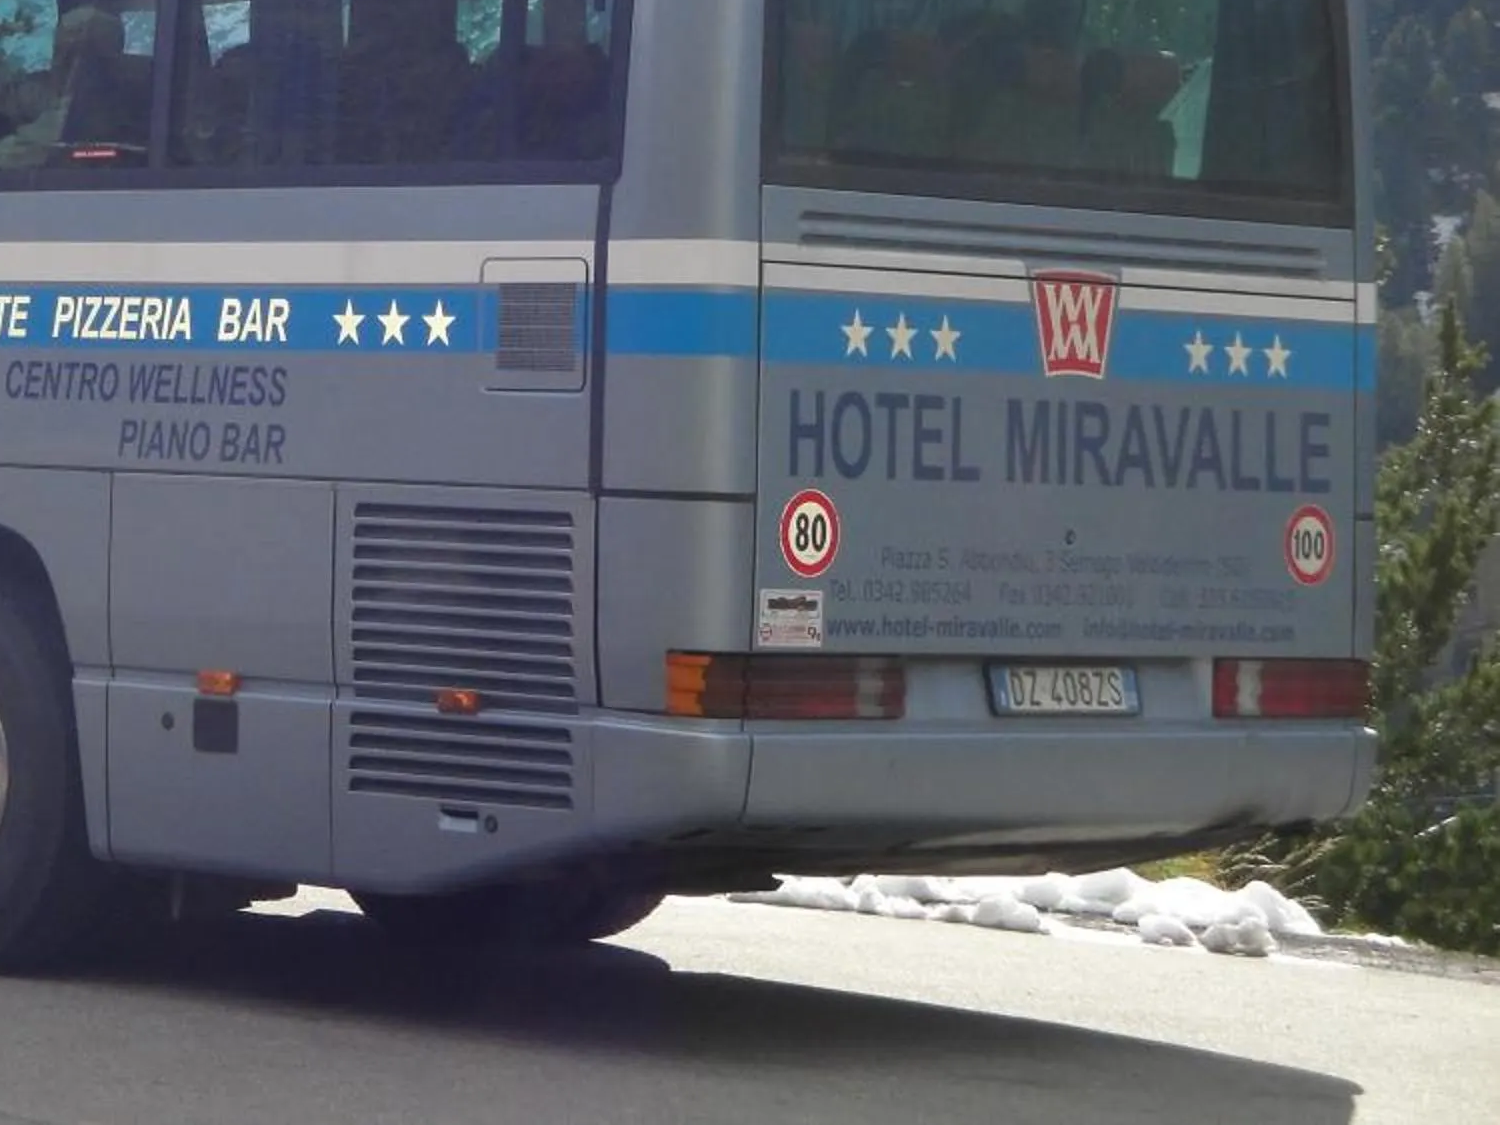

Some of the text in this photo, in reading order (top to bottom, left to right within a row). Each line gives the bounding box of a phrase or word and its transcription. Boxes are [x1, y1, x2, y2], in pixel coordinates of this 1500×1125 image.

[51, 296, 193, 341] PIZZERIA
[217, 298, 291, 342] BAR
[5, 361, 288, 408] CENTRO WELLNESS
[118, 420, 287, 464] PIANO BAR
[789, 390, 1331, 493] HOTEL MIRAVALLE
[795, 512, 827, 553] 80
[1294, 529, 1325, 560] 100
